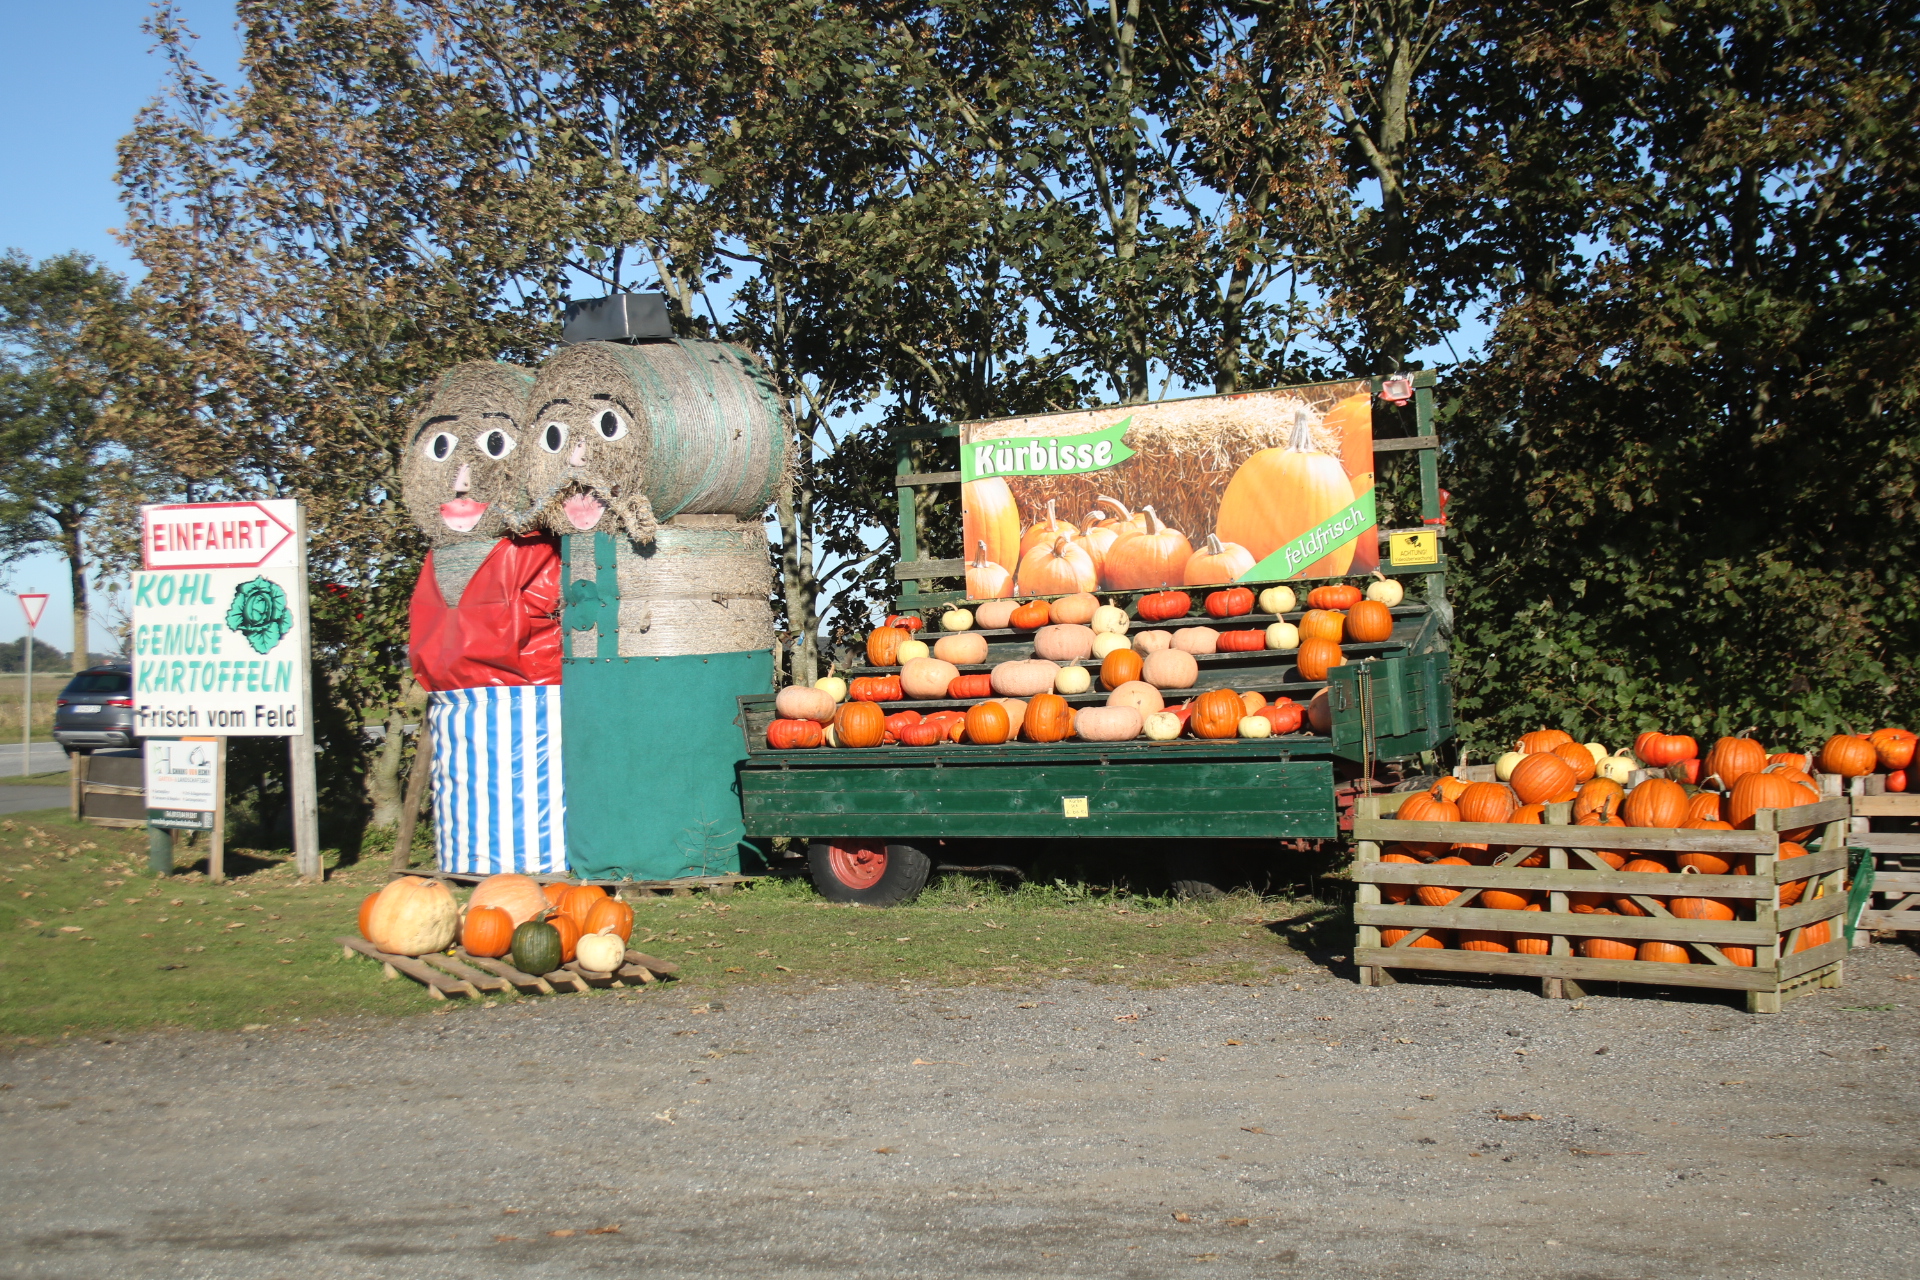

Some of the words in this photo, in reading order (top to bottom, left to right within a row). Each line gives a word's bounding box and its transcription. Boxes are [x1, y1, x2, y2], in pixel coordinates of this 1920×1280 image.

[975, 439, 1114, 476] Kürbisse
[153, 520, 270, 552] EINFAHRT
[1284, 506, 1366, 573] feldfrisch
[135, 573, 216, 608] KOHL
[136, 615, 224, 656] GEMÜSE
[138, 660, 294, 694] KARTOFFELN
[139, 704, 200, 728] Frisch
[207, 709, 247, 728] vom
[255, 704, 297, 728] Feld
